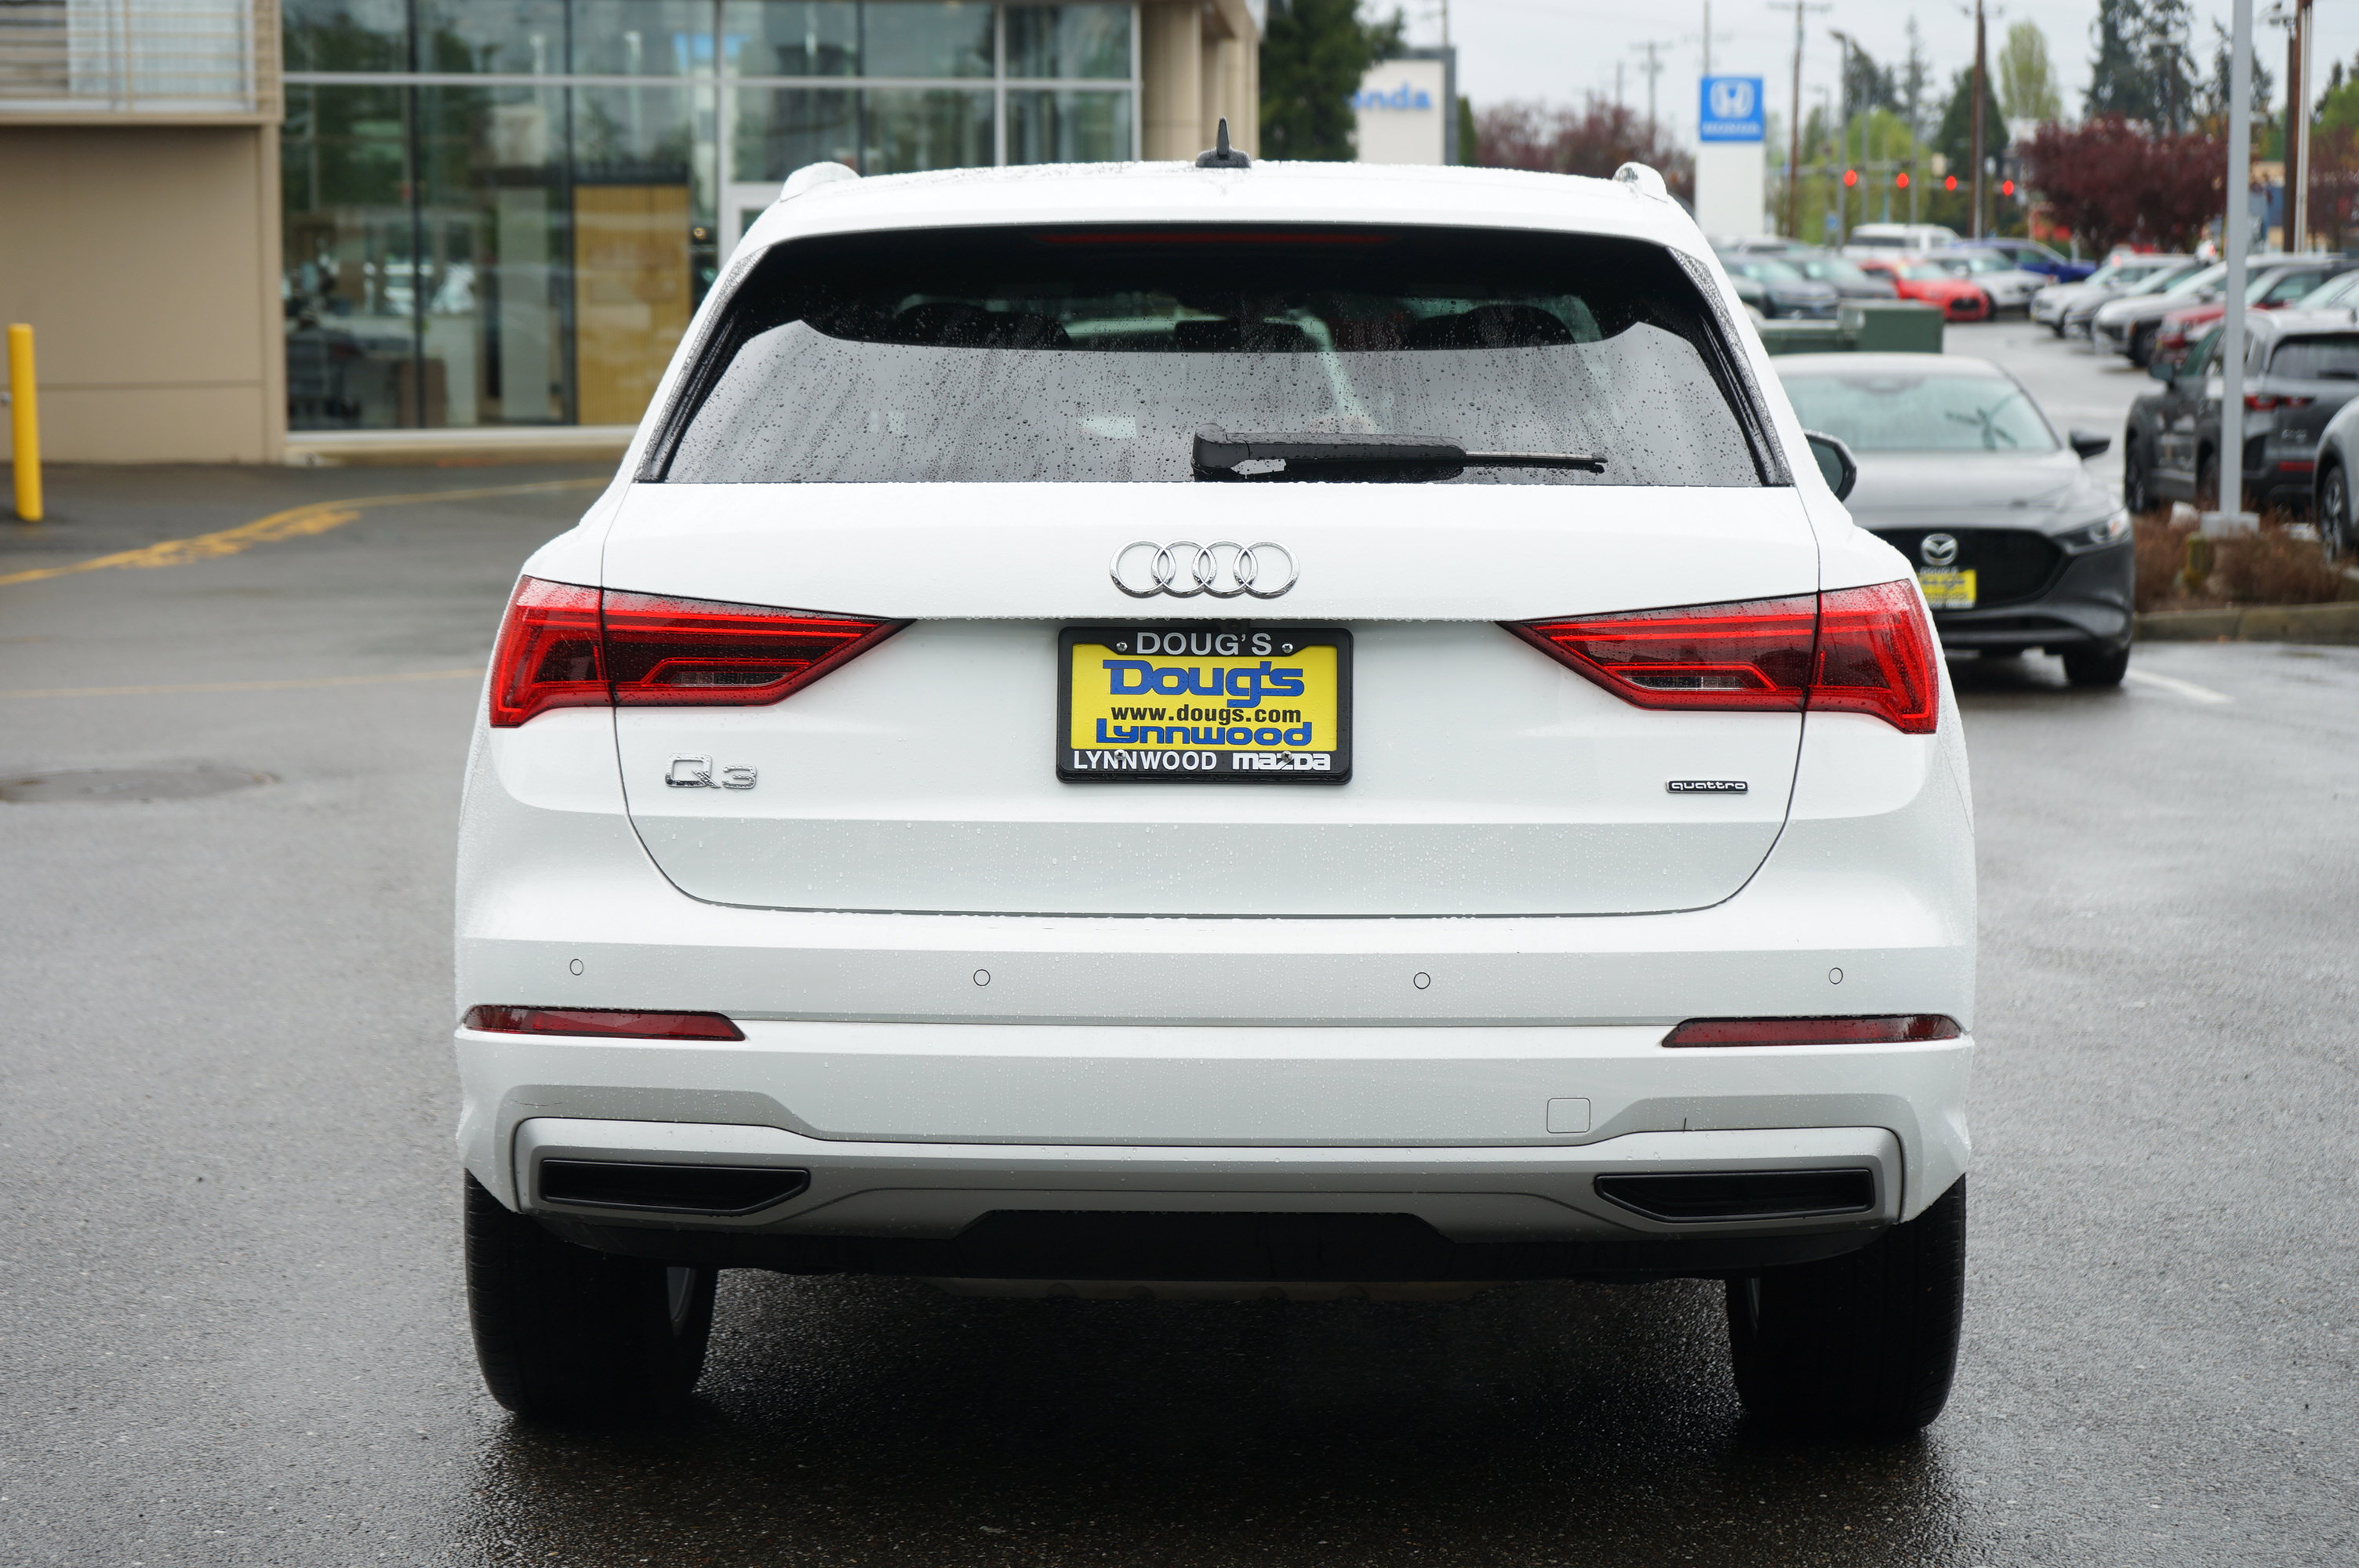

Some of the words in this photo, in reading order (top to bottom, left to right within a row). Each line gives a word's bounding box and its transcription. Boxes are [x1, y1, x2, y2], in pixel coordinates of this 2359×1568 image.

[1136, 632, 1272, 655] DOUG'S
[1103, 659, 1305, 708] Doug's
[1111, 704, 1301, 726] www.dougs.com
[1096, 718, 1312, 746] Lynnwood
[665, 753, 758, 789] Q3
[1073, 750, 1217, 771] LYNNWOOD
[1671, 782, 1746, 790] quattro
